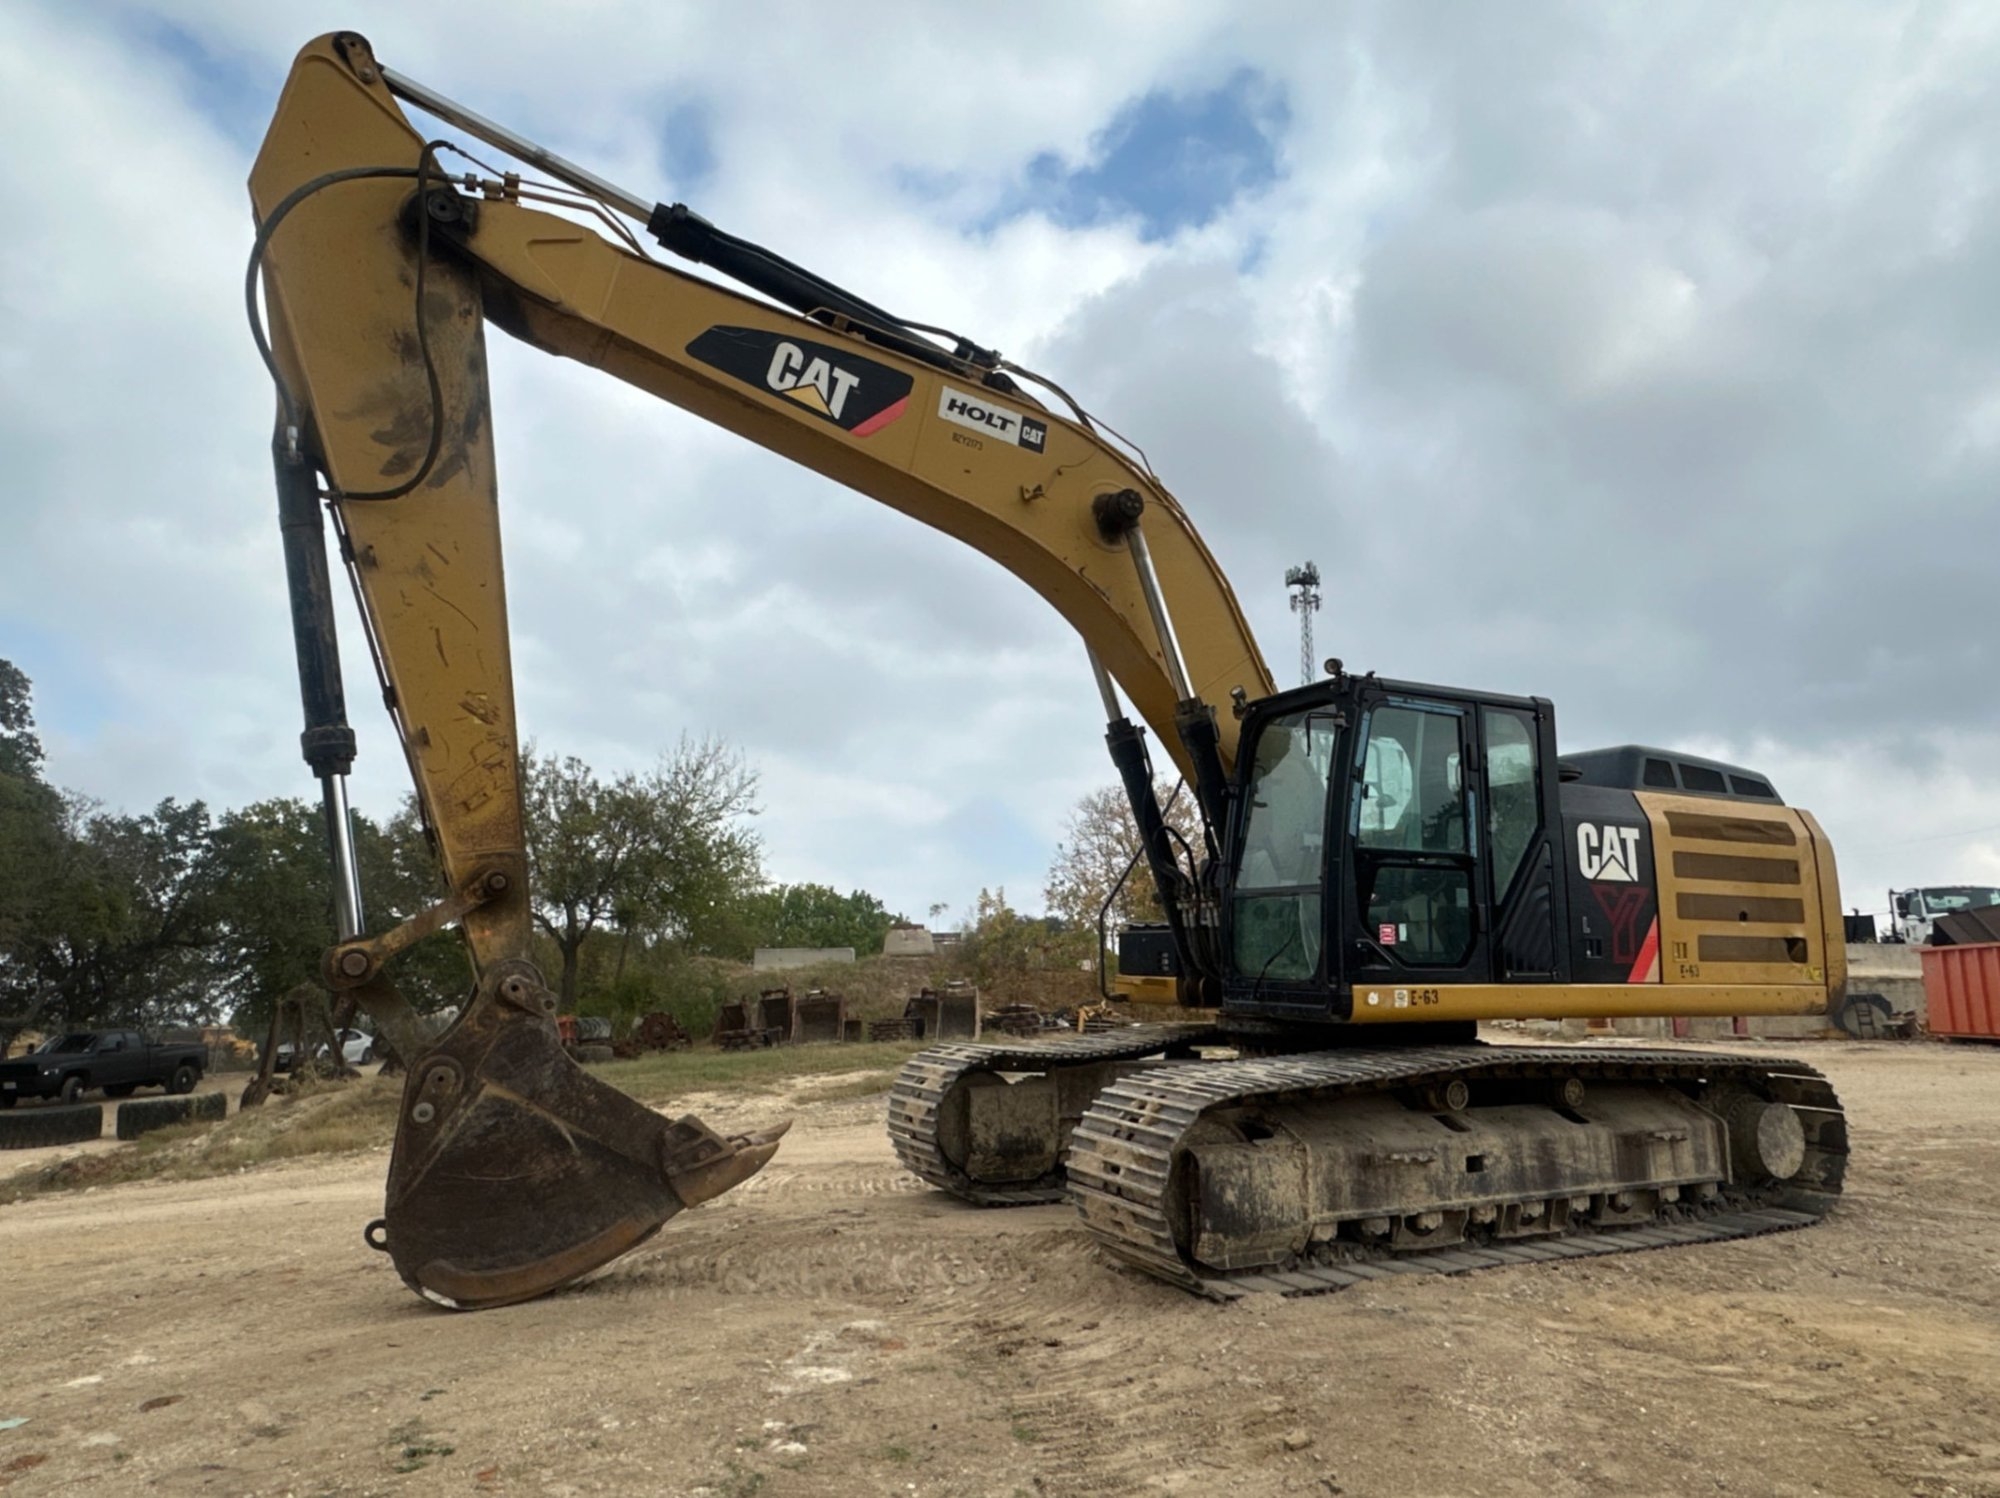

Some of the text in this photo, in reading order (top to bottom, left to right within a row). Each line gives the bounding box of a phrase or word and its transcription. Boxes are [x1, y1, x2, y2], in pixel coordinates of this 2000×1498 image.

[766, 341, 860, 420] CAT
[947, 398, 1045, 445] HOLT CAT
[1576, 822, 1640, 882] CAT
[1410, 989, 1439, 1006] E-63
